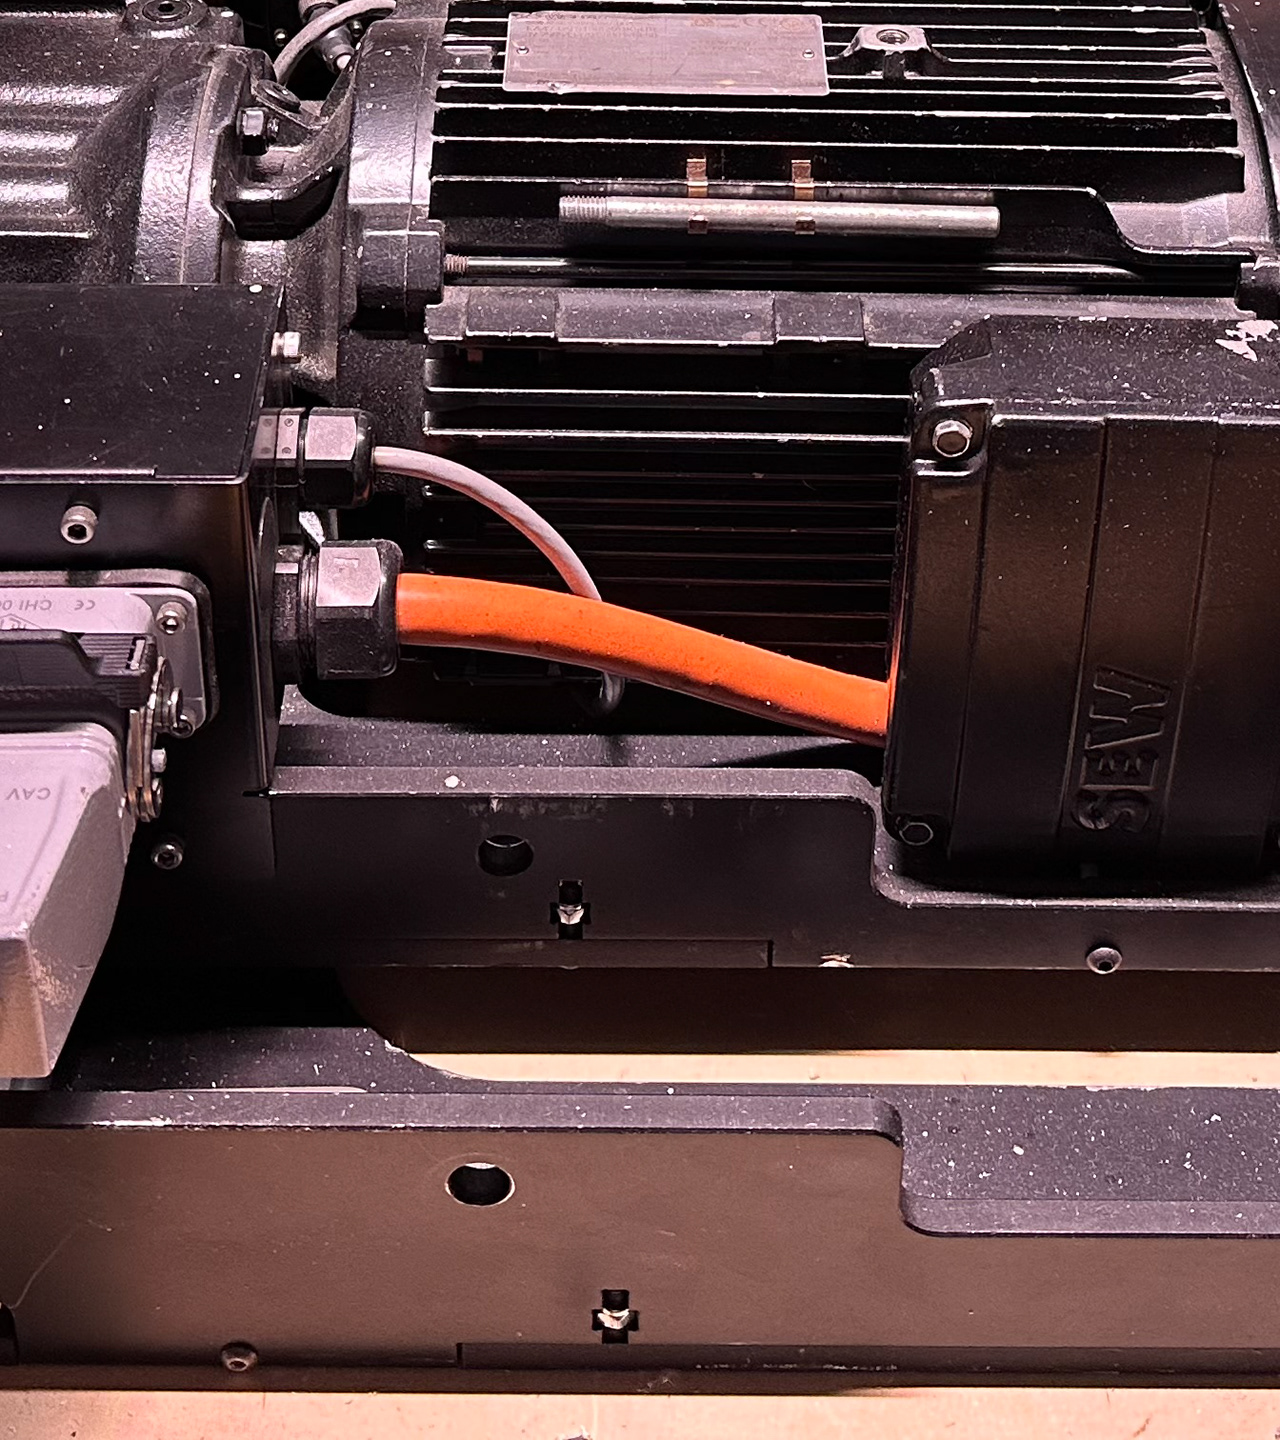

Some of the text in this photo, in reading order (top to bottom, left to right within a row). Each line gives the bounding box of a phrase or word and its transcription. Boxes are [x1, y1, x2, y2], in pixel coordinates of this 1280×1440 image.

[19, 599, 52, 611] CHI
[1071, 663, 1172, 833] SEW
[7, 787, 51, 801] CAV
